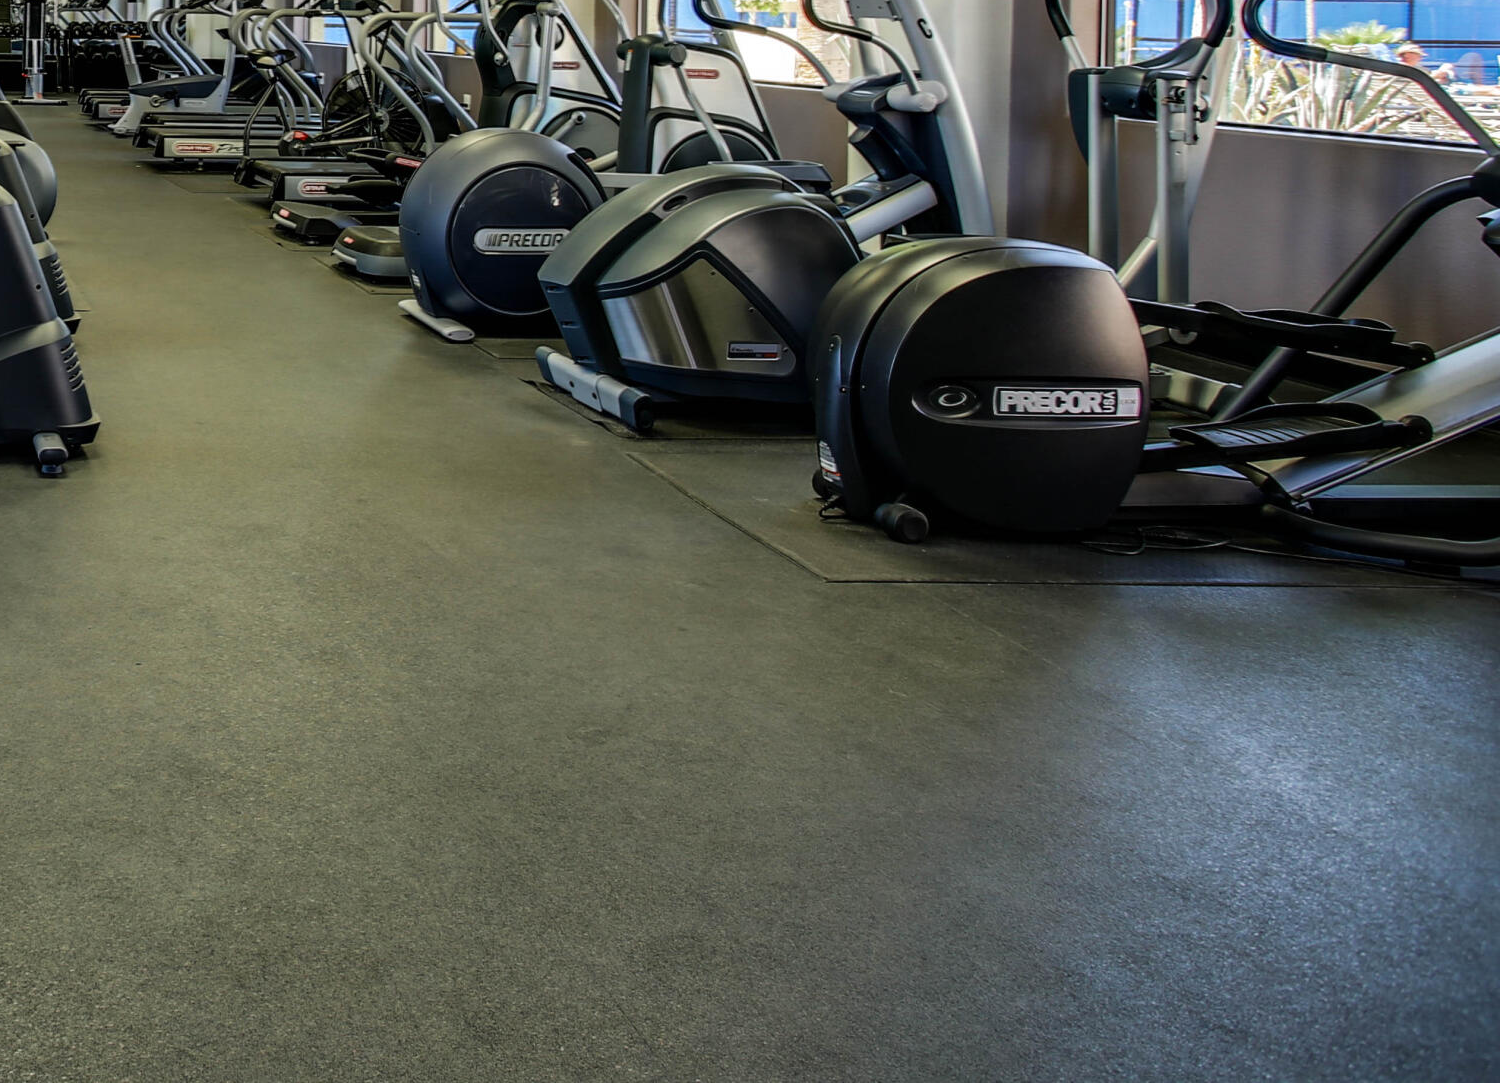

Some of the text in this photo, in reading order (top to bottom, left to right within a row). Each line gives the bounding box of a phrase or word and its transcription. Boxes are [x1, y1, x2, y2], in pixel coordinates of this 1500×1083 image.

[496, 232, 566, 248] PRECOR
[999, 389, 1117, 414] PRECOR USA
